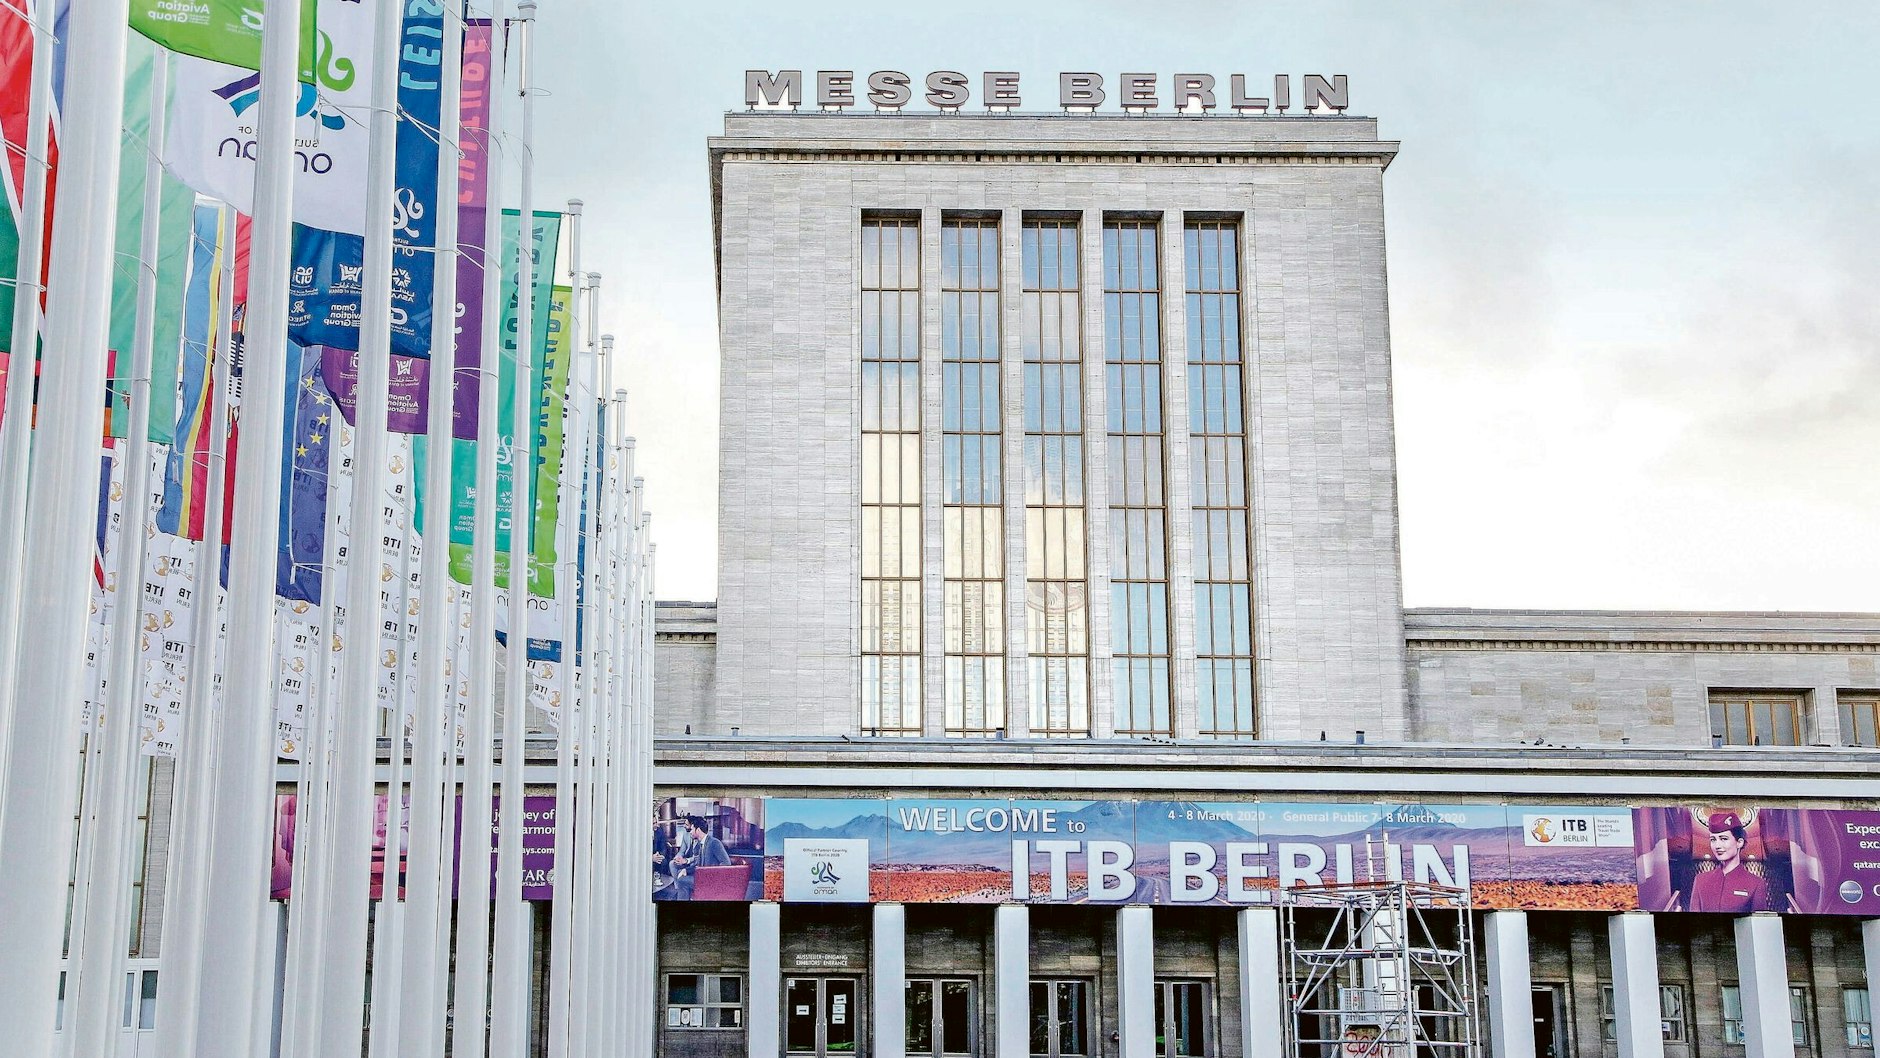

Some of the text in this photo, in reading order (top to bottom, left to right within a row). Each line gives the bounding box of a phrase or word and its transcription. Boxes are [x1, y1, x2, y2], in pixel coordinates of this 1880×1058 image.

[745, 70, 1347, 109] MESSE BERLIN
[542, 809, 555, 820] of
[899, 807, 1085, 833] WELCOME to
[1168, 810, 1177, 821] 4
[1186, 810, 1193, 820] 8
[1197, 809, 1233, 822] March
[1237, 810, 1265, 821] 2020
[1283, 811, 1329, 822] General
[1332, 811, 1367, 823] Public
[1397, 811, 1433, 823] March
[1437, 812, 1466, 823] 2020
[1562, 820, 1587, 831] ITB
[1563, 835, 1588, 843] BERLIN
[1012, 840, 1471, 904] ITB BERLIN
